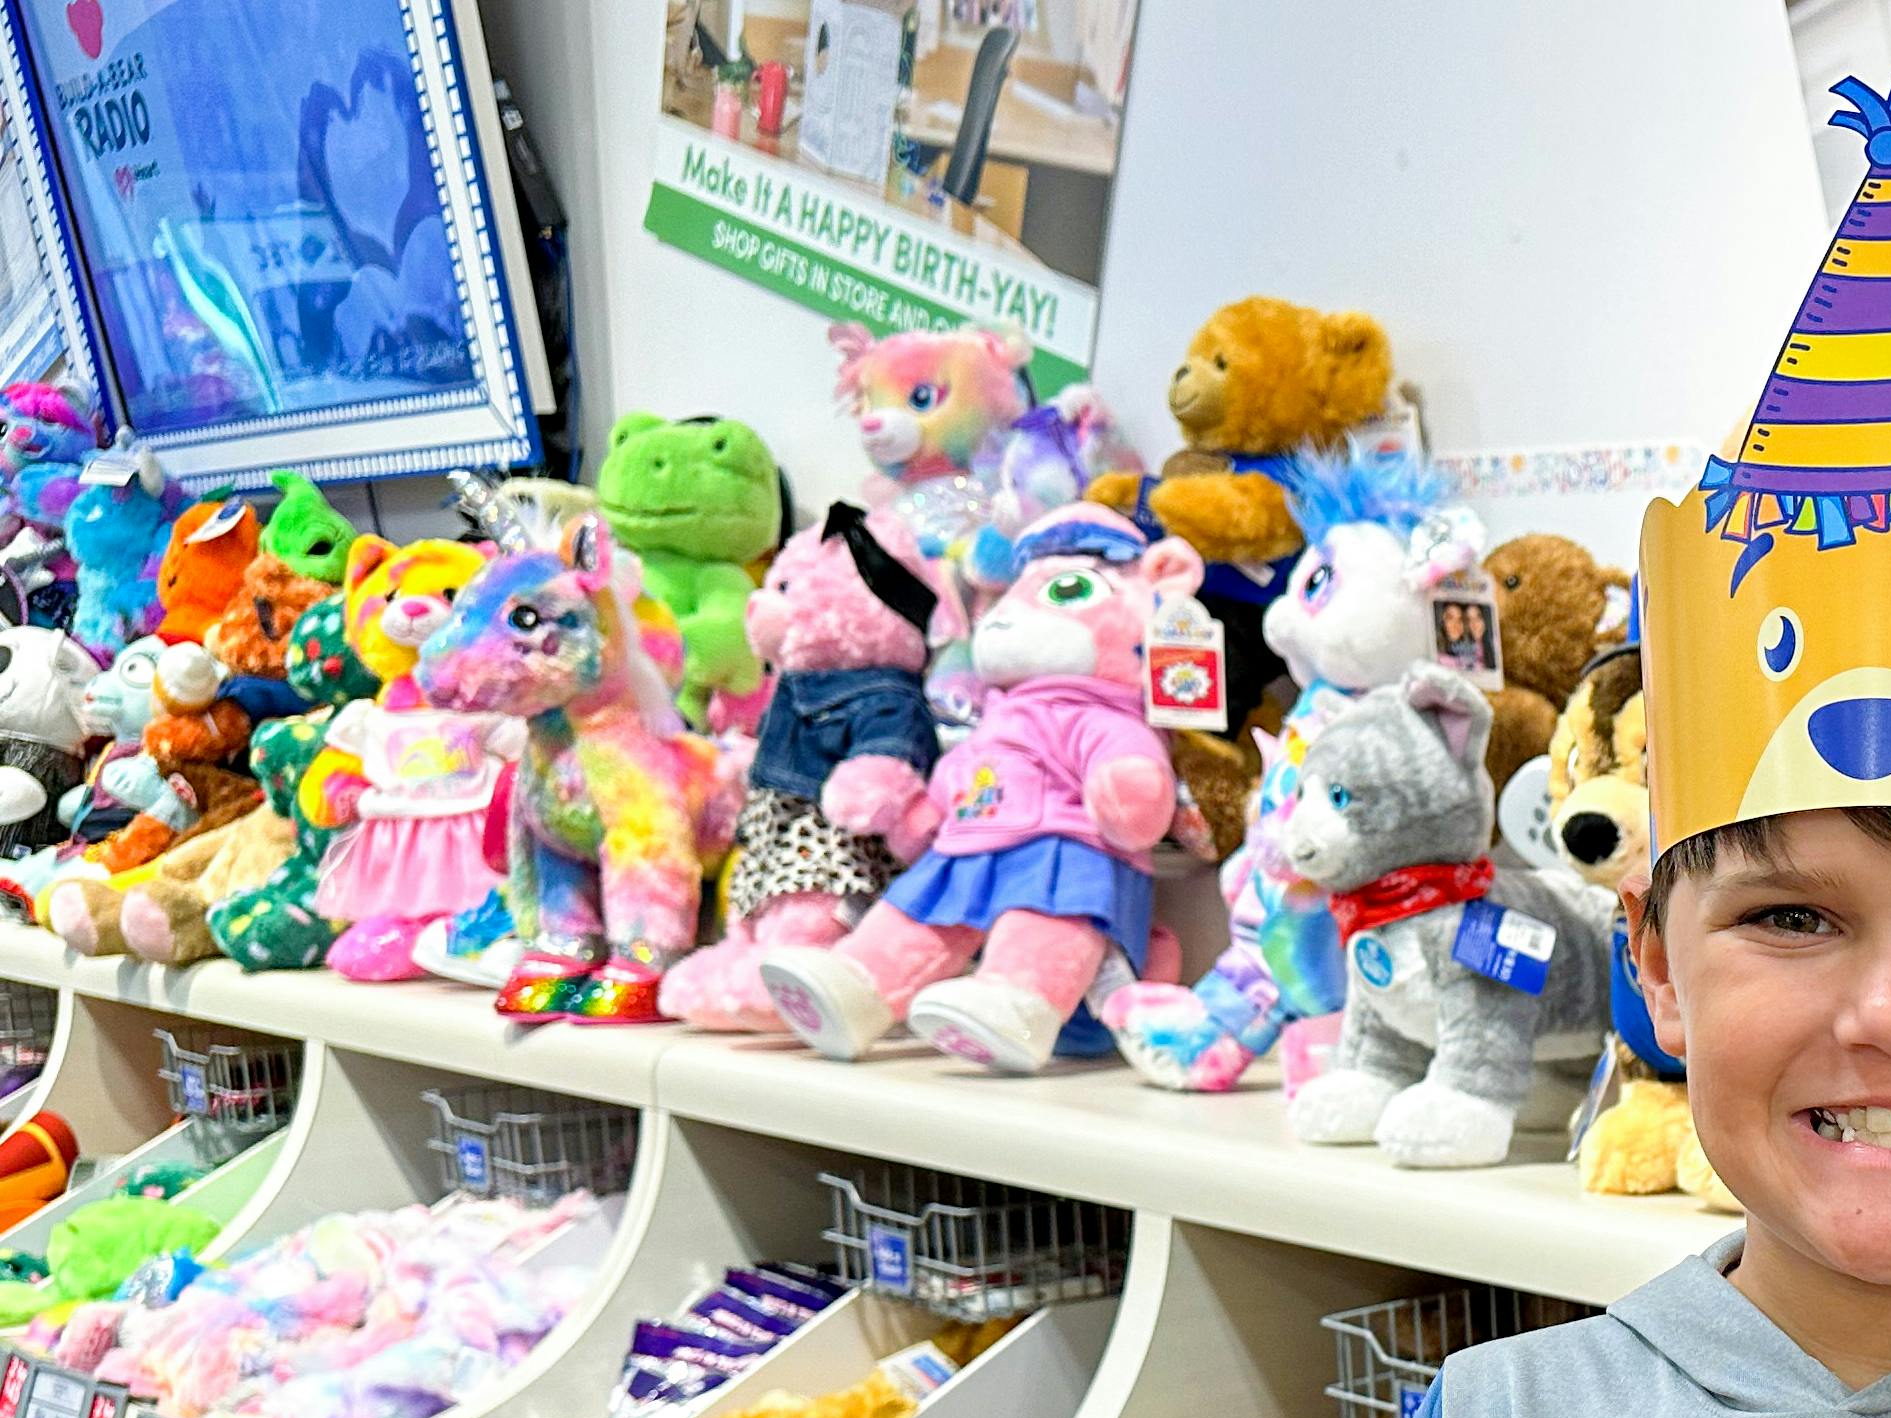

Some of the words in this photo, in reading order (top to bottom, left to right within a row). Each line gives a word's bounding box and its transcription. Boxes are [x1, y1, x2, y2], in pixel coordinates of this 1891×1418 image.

[73, 88, 150, 160] RADIO
[681, 144, 748, 208] Make
[753, 173, 772, 217] It
[774, 183, 793, 227] A
[800, 191, 894, 266] HAPPY
[892, 233, 1058, 340] BIRTH-YAY!
[711, 219, 760, 262] SHOP
[759, 242, 808, 286] GIFTS
[808, 264, 830, 296] IN
[831, 275, 889, 322] STORE
